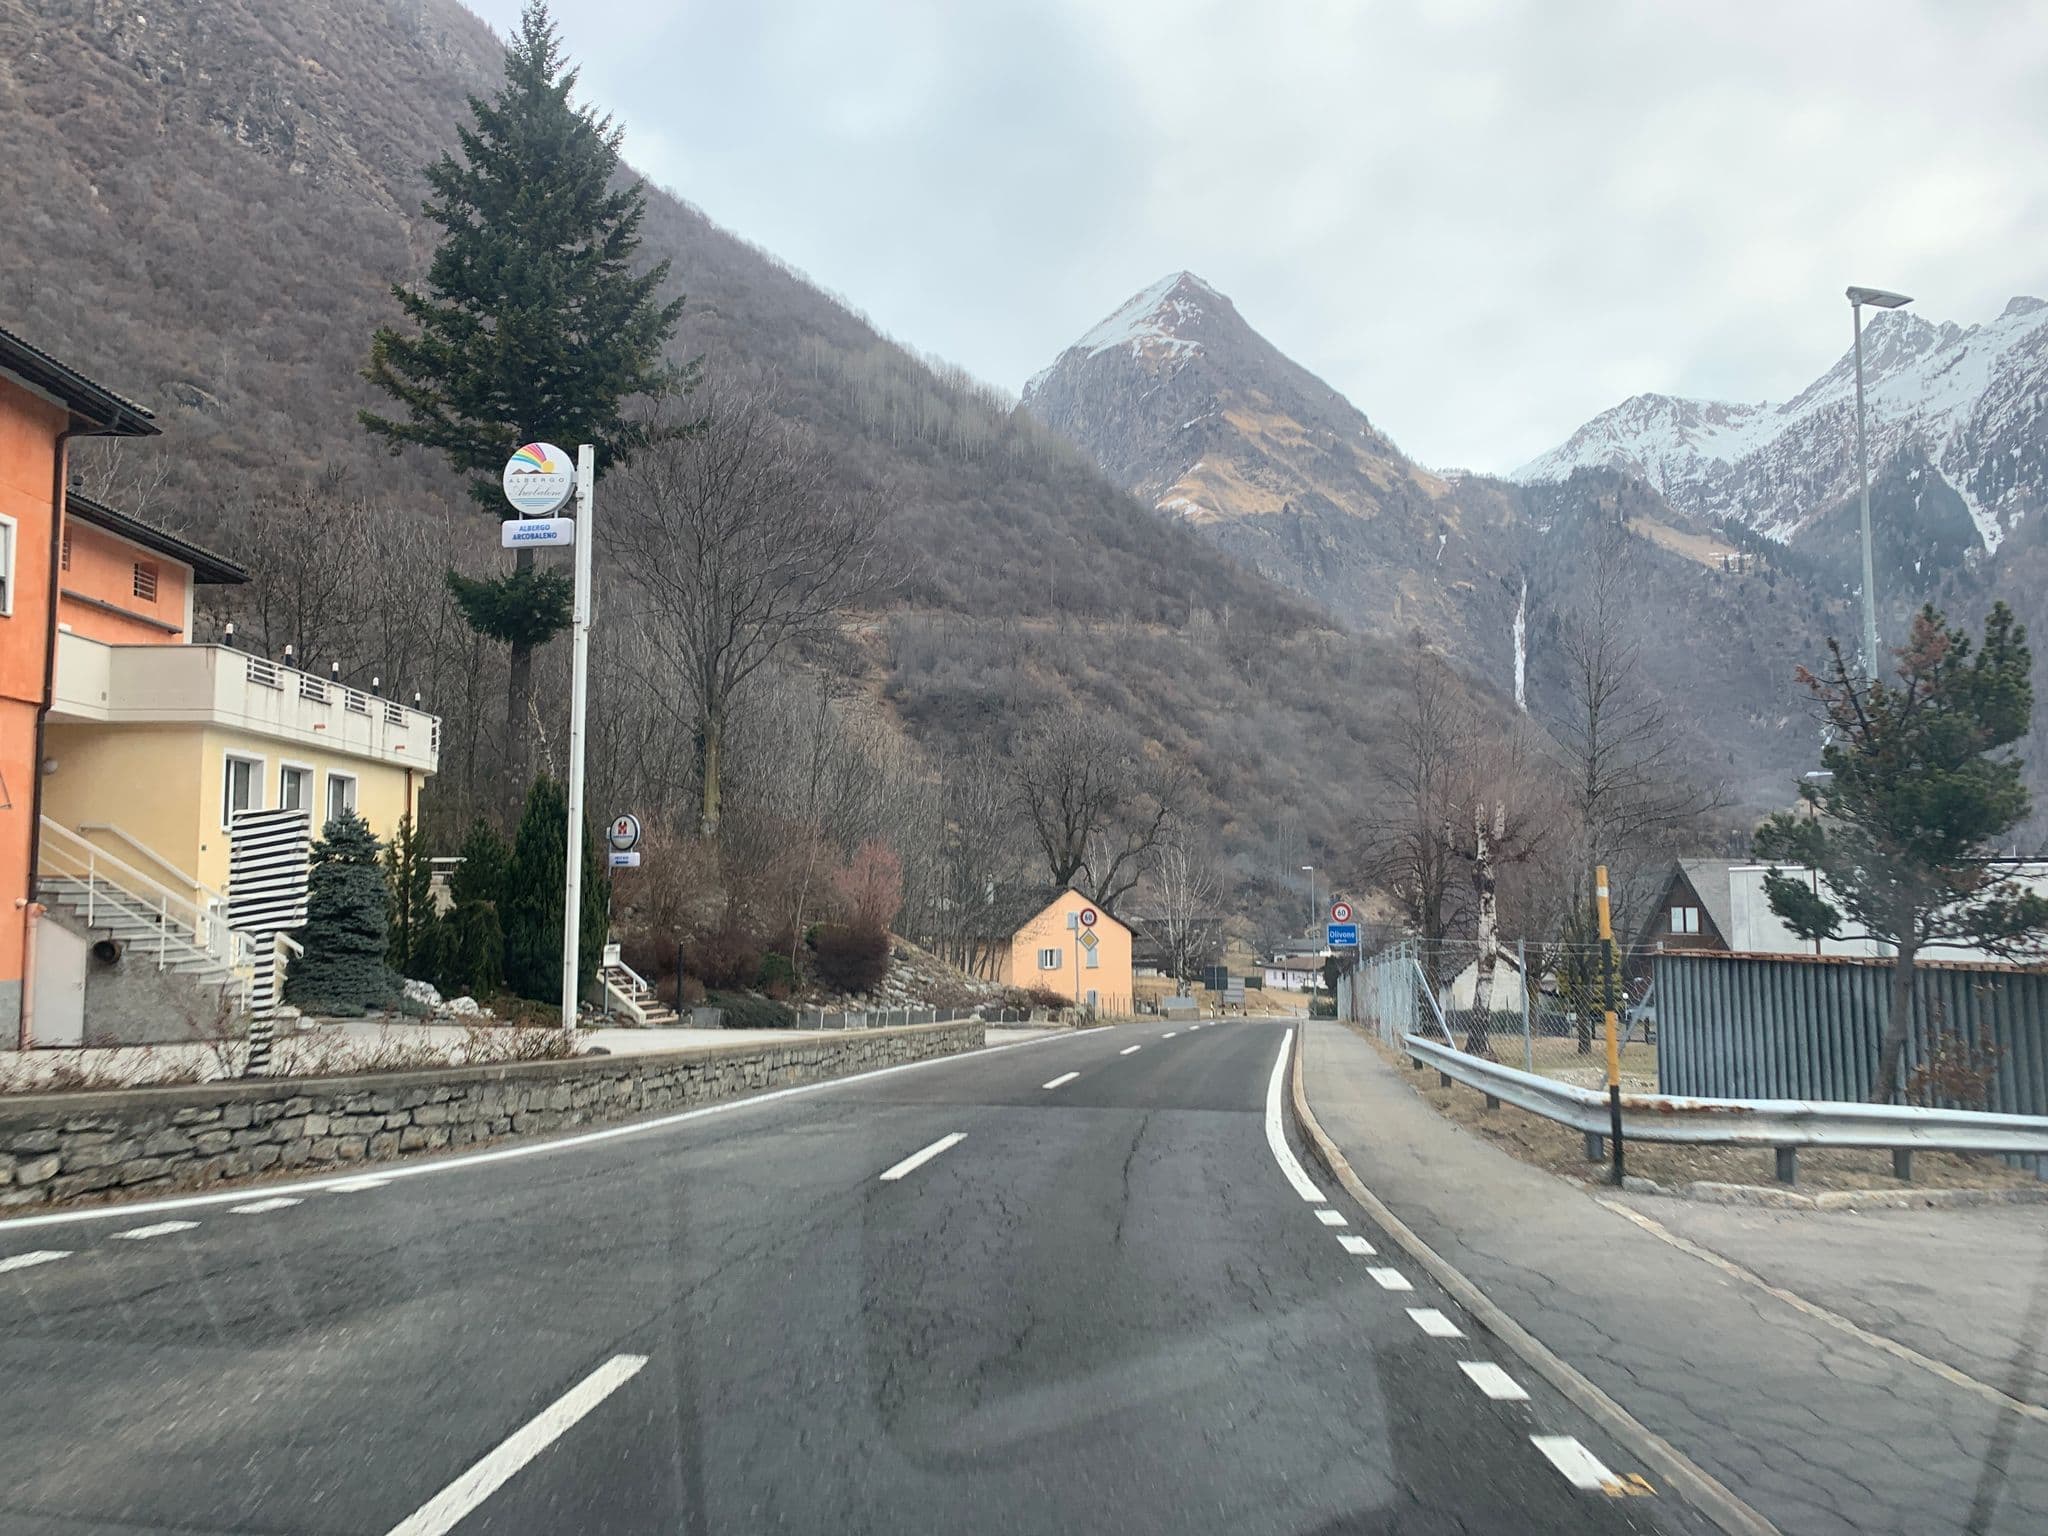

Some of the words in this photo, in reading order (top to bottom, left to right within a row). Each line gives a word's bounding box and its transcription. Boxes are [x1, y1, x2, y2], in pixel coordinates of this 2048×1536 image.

[512, 532, 557, 540] ARCOBALENO
[1337, 909, 1346, 917] 60
[1330, 930, 1355, 939] Olivone
